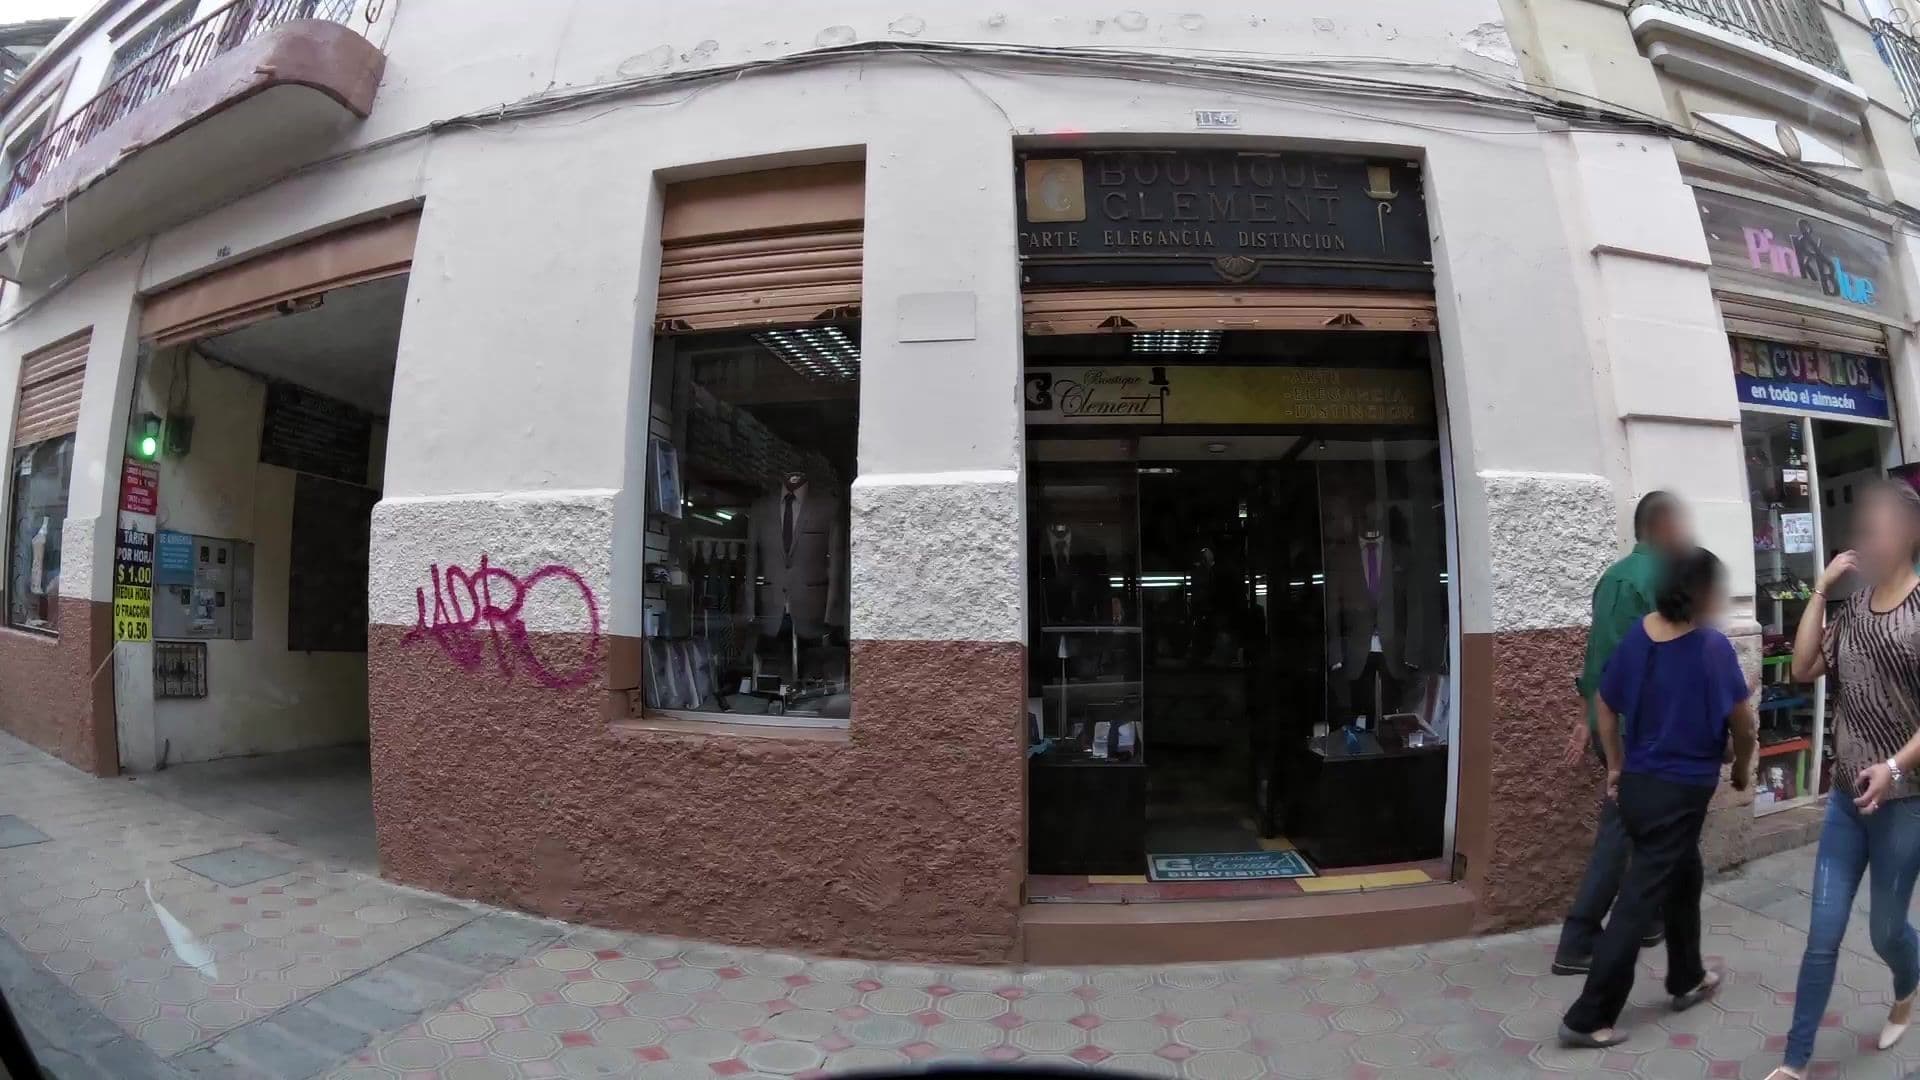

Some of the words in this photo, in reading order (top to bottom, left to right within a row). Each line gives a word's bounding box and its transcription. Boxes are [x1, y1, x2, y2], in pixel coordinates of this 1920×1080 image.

[1100, 156, 1339, 190] BOUTIQUE
[1102, 190, 1340, 226] CLEMENT
[1238, 231, 1345, 251] DISTINCION
[1054, 379, 1152, 414] Clement
[1751, 385, 1767, 399] en
[1768, 385, 1798, 403] todo
[1800, 389, 1809, 405] el
[1812, 391, 1856, 410] almacén
[124, 531, 148, 546] TARIFA
[116, 547, 132, 560] POR
[118, 564, 125, 582] $
[128, 567, 151, 583] 1.00
[118, 621, 125, 639] $
[127, 621, 147, 639] 0.50
